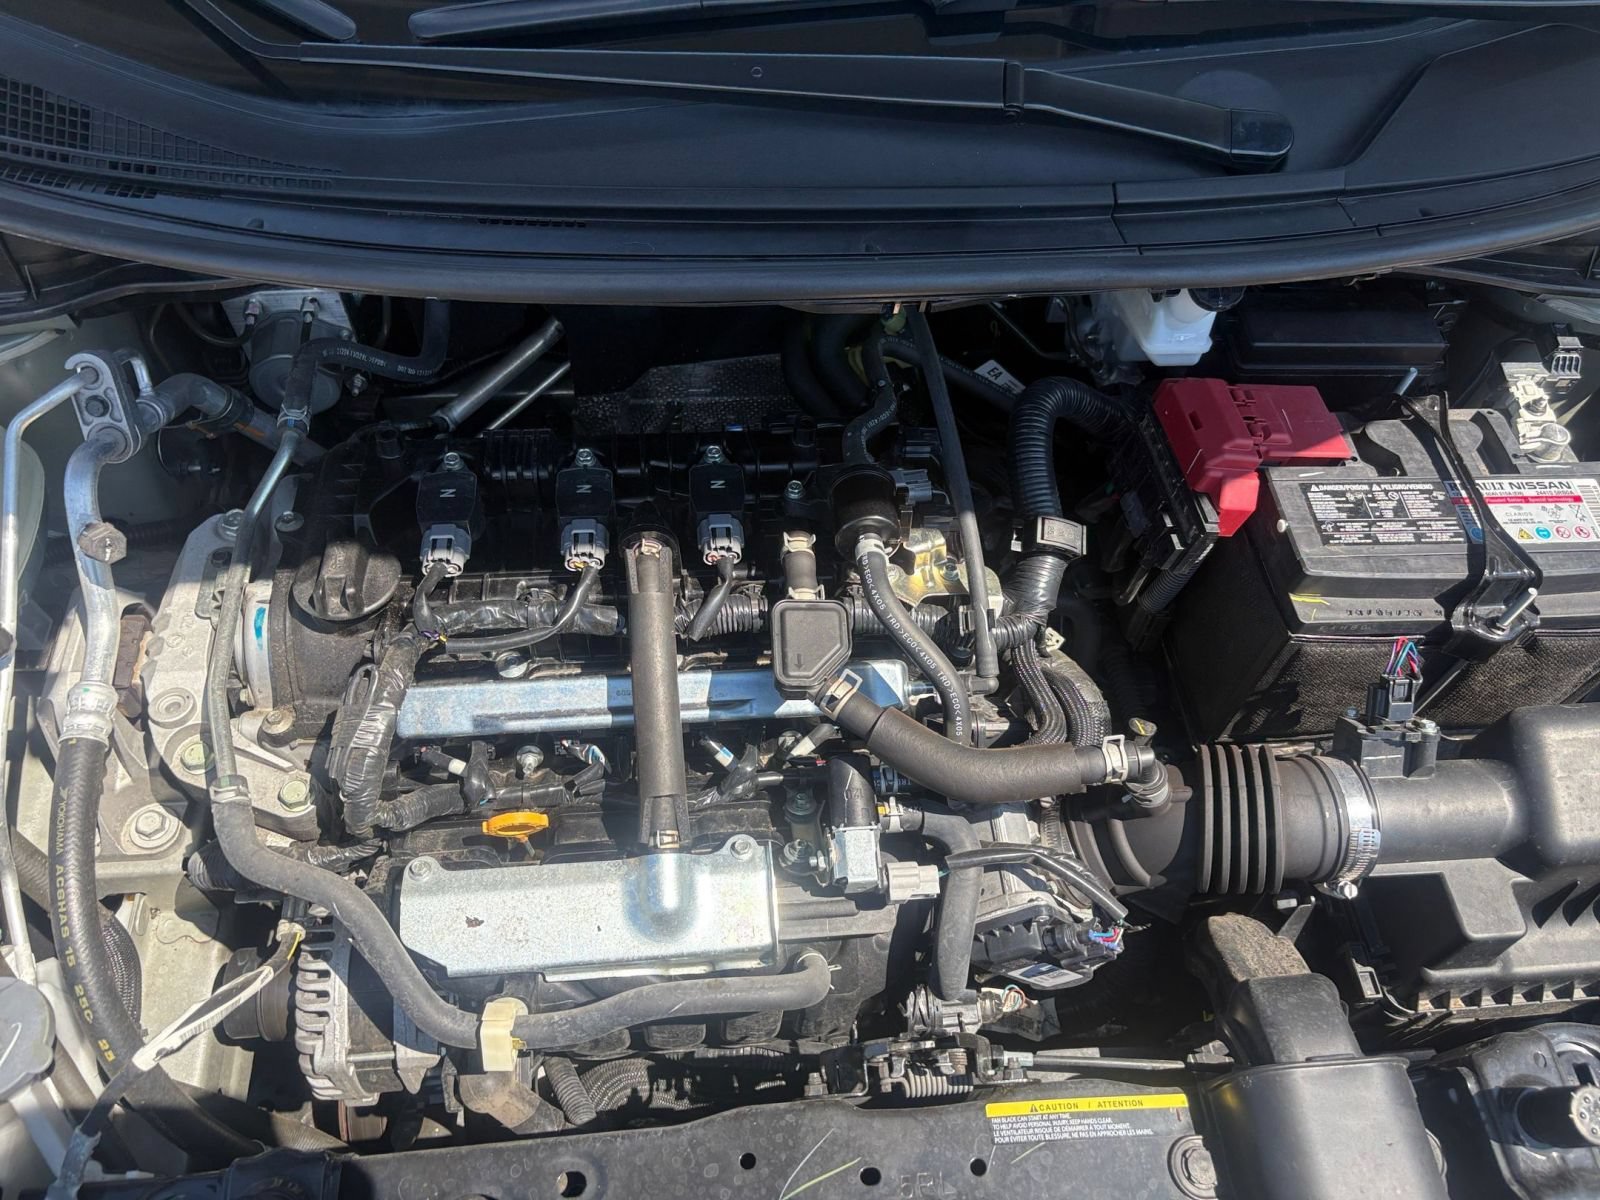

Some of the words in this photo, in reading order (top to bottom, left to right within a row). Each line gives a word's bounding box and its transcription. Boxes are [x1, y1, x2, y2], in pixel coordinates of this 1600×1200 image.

[1510, 481, 1572, 490] NISSAN
[56, 801, 66, 855] YOKOHAMA
[65, 946, 76, 967] 15
[1039, 1103, 1079, 1111] CAUTION
[1097, 1100, 1144, 1108] ATTENTION
[1000, 1128, 1034, 1136] VENTILATEUR
[1097, 1130, 1126, 1138] APPROCHER
